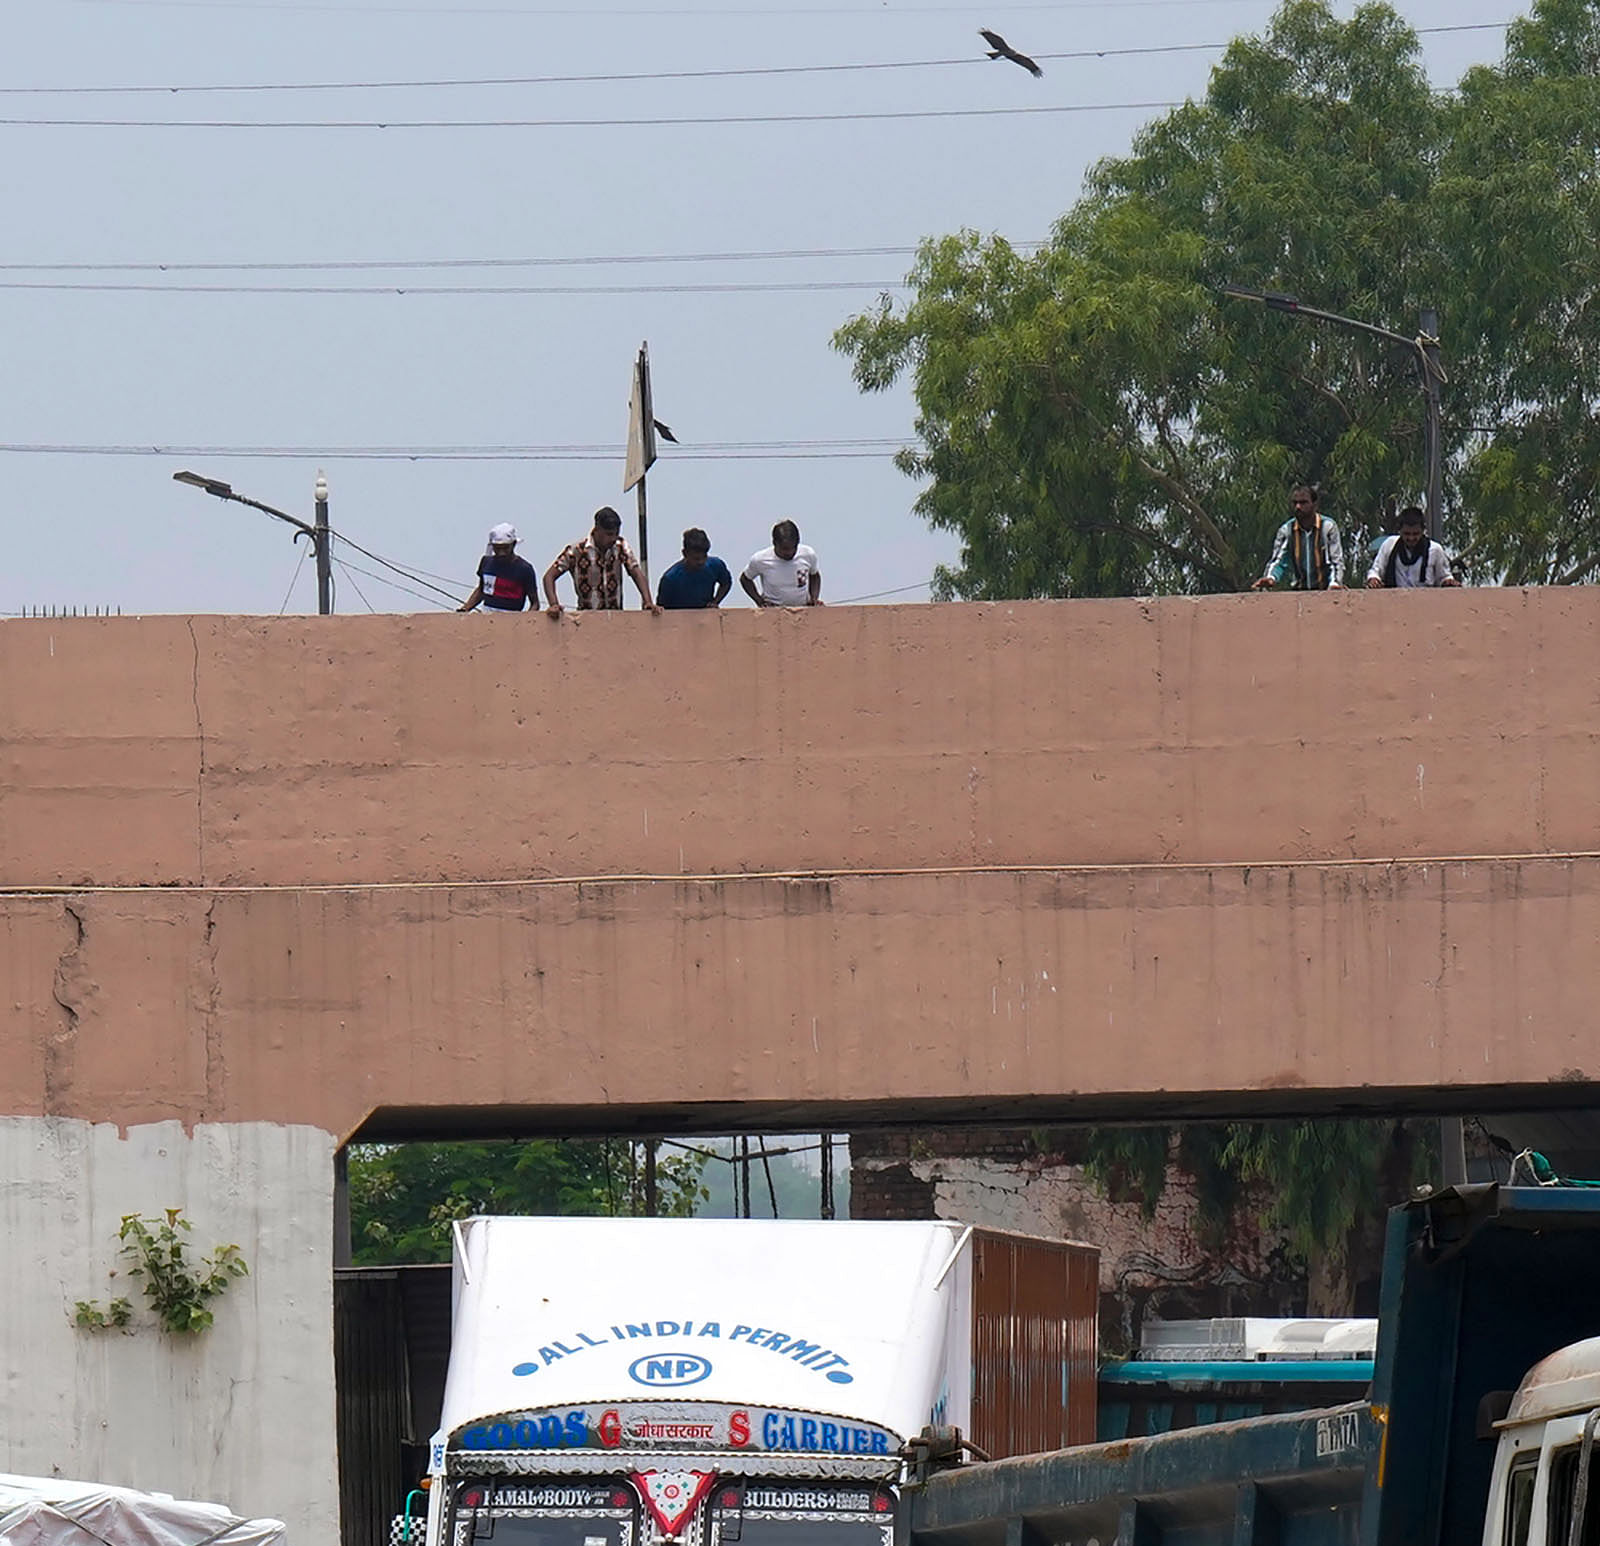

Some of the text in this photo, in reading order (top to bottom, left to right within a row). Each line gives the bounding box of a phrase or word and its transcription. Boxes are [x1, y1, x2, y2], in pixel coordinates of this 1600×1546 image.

[538, 1321, 850, 1372] ALL INDIA PERMIT
[646, 1359, 700, 1380] NP
[463, 1409, 590, 1451] GOODS
[600, 1409, 622, 1448] G
[728, 1410, 750, 1448] S
[762, 1411, 888, 1455] CARRIER
[543, 1490, 586, 1506] BODY
[744, 1490, 827, 1509] BUILDERS
